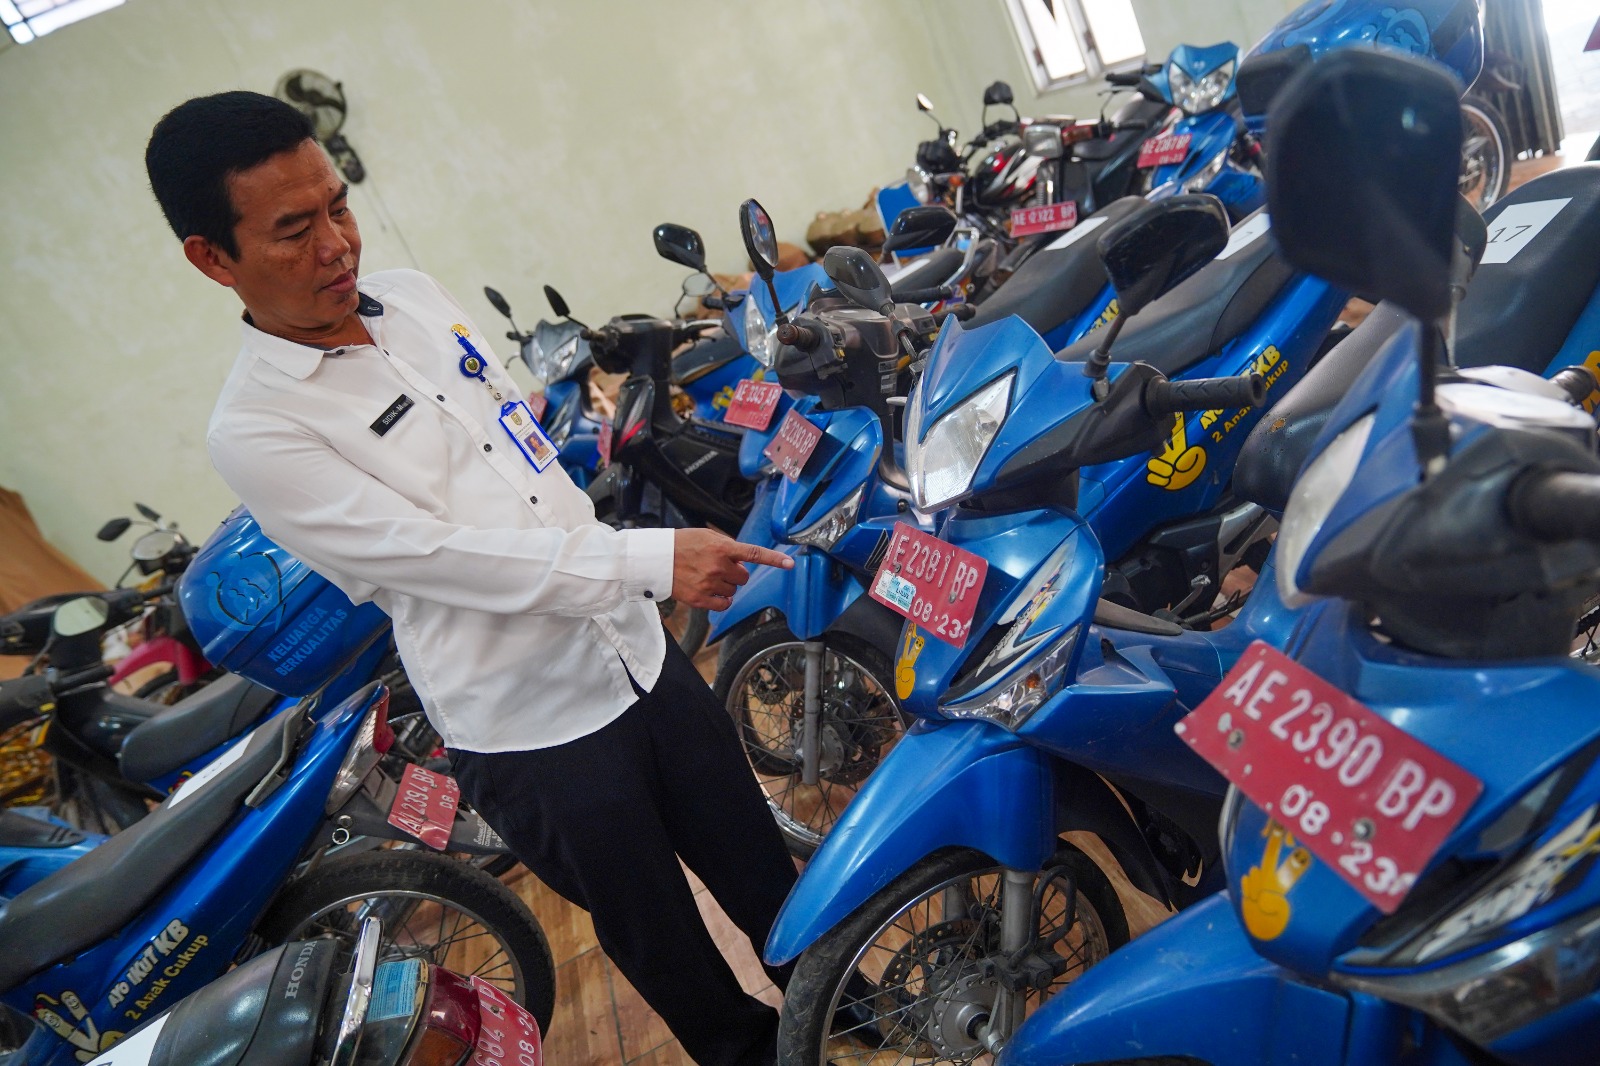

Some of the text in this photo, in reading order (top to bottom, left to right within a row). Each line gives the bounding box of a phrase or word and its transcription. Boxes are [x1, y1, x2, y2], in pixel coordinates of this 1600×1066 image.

[1486, 224, 1533, 244] 17
[1200, 344, 1281, 430] AY KB
[1211, 430, 1223, 443] 2
[905, 540, 951, 588] 2381
[949, 561, 979, 602] BP
[267, 607, 329, 662] KELUARGA
[274, 608, 348, 677] BERKUALITAS
[1223, 660, 1456, 831] AE 2390 BP
[125, 934, 209, 1021] 2 Anak Cukup
[126, 944, 159, 986] IKUT
[153, 918, 189, 957] KB
[284, 939, 318, 1000] HONDA
